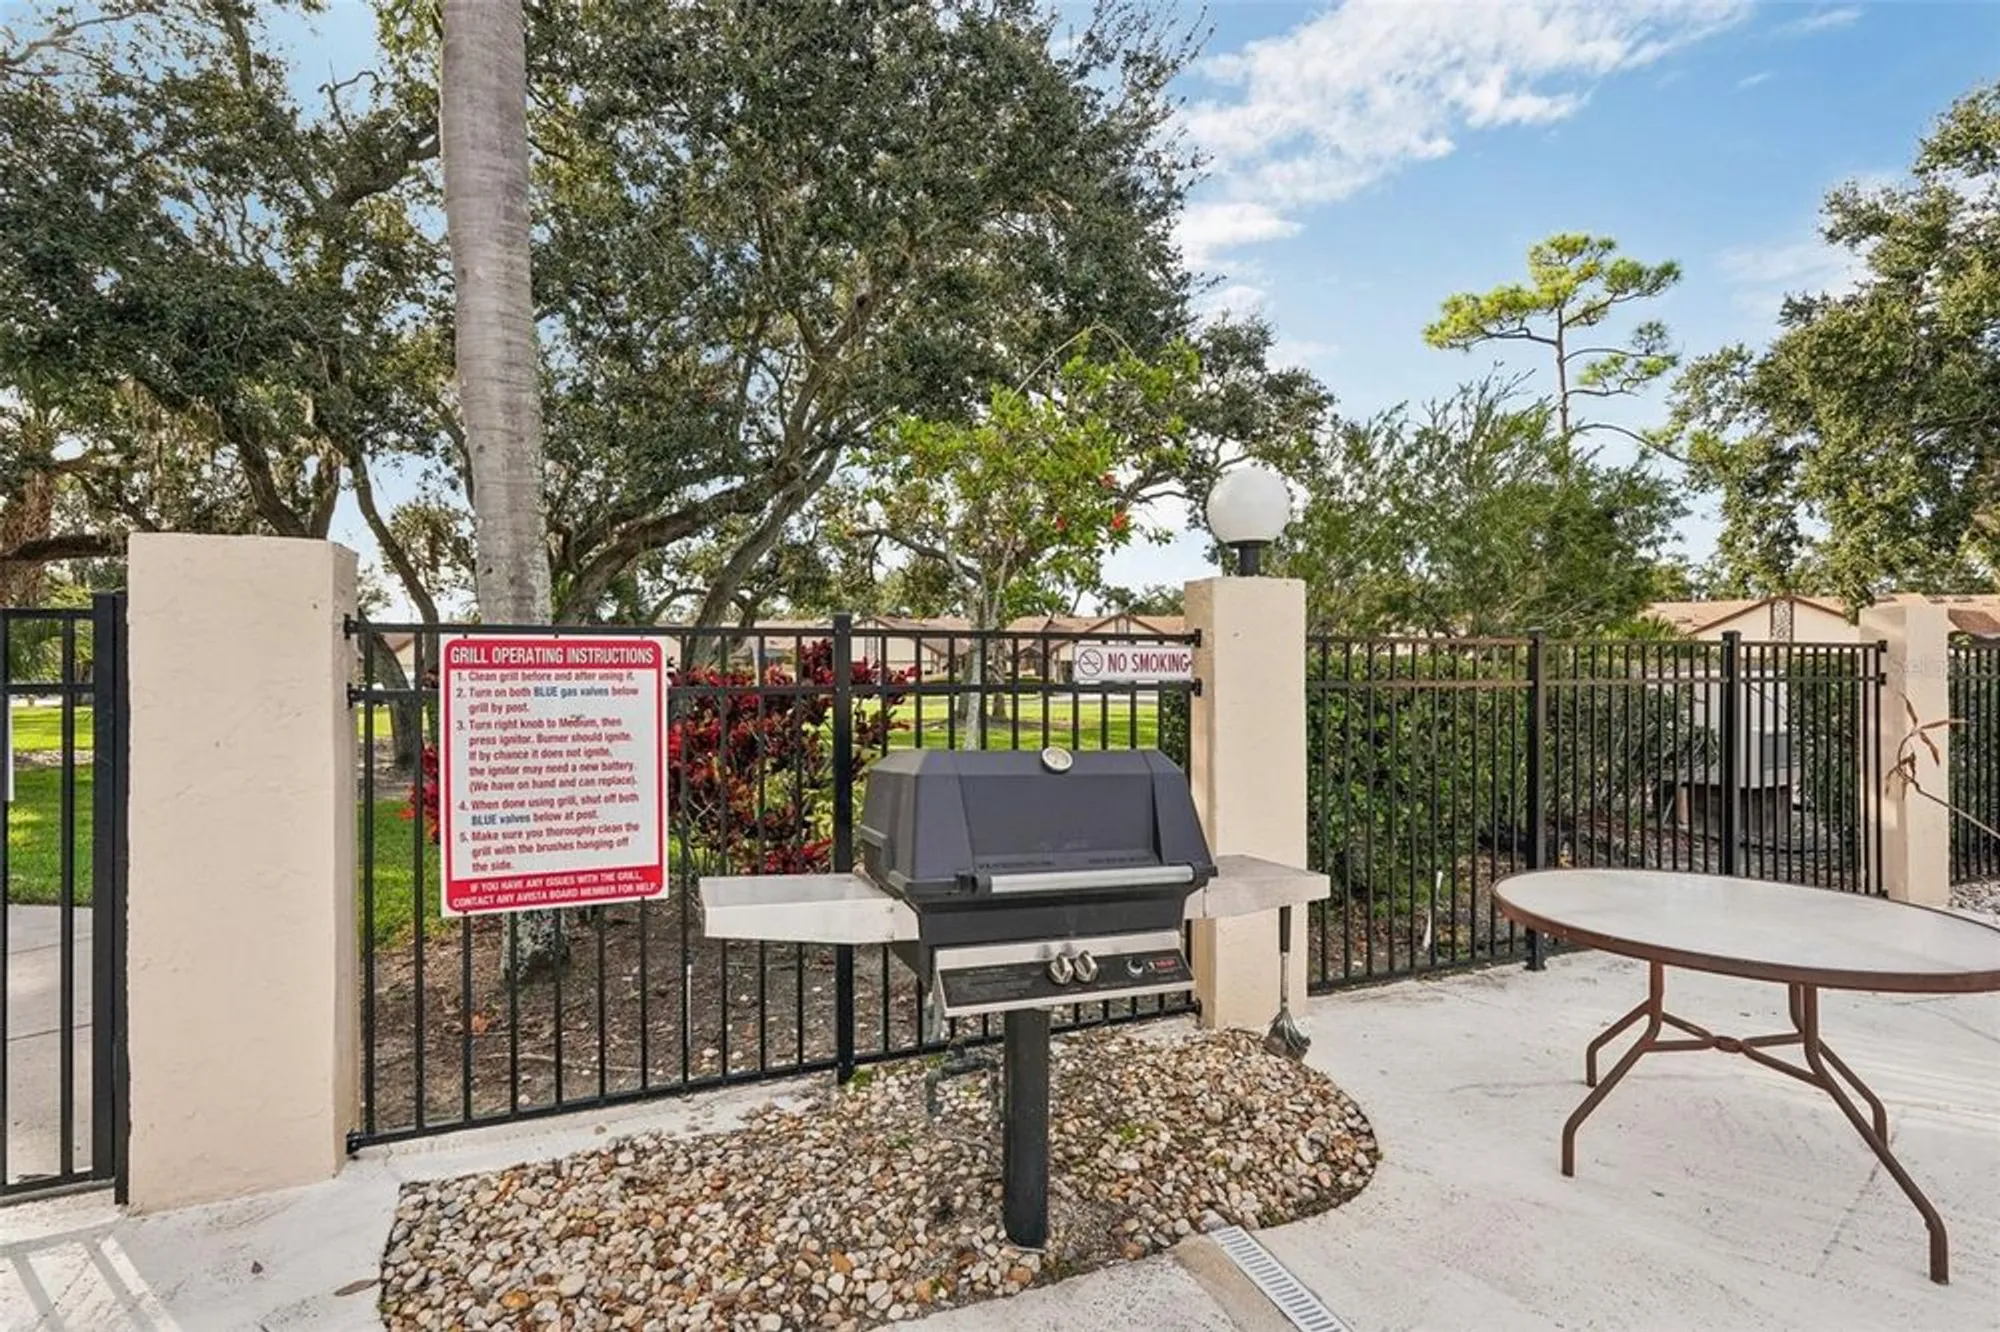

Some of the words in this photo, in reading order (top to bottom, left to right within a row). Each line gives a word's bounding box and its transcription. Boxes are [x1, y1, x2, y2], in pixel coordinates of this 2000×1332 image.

[451, 647, 488, 664] GRILL
[492, 647, 563, 664] OPERATING
[566, 647, 654, 664] INSTRUCTIONS
[1108, 653, 1127, 673] NO
[1131, 653, 1190, 673] SMOKING
[457, 672, 466, 681] 1.
[468, 672, 497, 681] Clean
[500, 672, 519, 683] grill
[521, 671, 552, 681] before
[555, 672, 573, 681] and
[575, 671, 596, 681] after
[599, 671, 624, 682] using
[626, 671, 635, 681] it.
[456, 688, 466, 698] 2.
[470, 687, 492, 697] Turn
[495, 689, 507, 697] on
[509, 687, 531, 697] both
[534, 686, 558, 697] BLUE
[561, 688, 578, 699] gas
[580, 687, 609, 696] valves
[612, 686, 639, 696] below
[468, 702, 489, 715] grill
[491, 702, 503, 714] by
[505, 703, 529, 714] post.
[456, 720, 466, 731] 3.
[470, 719, 492, 730] Turn
[495, 719, 518, 731] right
[521, 719, 544, 728] knob
[547, 718, 557, 728] to
[559, 717, 600, 729] Medium,
[602, 718, 623, 727] then
[469, 736, 497, 747] press
[500, 734, 535, 746] ignitor.
[537, 733, 569, 743] Burner
[572, 732, 603, 742] should
[469, 750, 477, 760] If
[479, 751, 491, 762] by
[494, 750, 529, 760] chance
[531, 749, 539, 758] it
[541, 748, 563, 758] does
[566, 748, 581, 757] not
[584, 747, 613, 758] ignite,
[469, 767, 485, 776] the
[488, 765, 520, 777] ignitor
[522, 766, 543, 775] may
[546, 763, 569, 773] need
[571, 764, 577, 772] a
[579, 763, 599, 771] new
[469, 781, 489, 794] (We
[491, 781, 515, 791] have
[517, 780, 530, 789] on
[532, 779, 556, 789] hand
[559, 779, 577, 788] and
[579, 778, 596, 787] can
[458, 801, 468, 811] 4.
[471, 800, 500, 811] When
[502, 799, 526, 809] done
[528, 798, 555, 809] using
[557, 795, 580, 807] grill,
[582, 794, 601, 805] shut
[604, 793, 617, 803] off
[619, 793, 640, 803] both
[472, 814, 497, 826] BLUE
[500, 813, 531, 824] valves
[533, 811, 562, 822] below
[565, 811, 575, 820] at
[577, 809, 599, 821] post.
[459, 831, 469, 842] 5.
[472, 831, 499, 841] Make
[502, 830, 524, 840] sure
[526, 829, 544, 840] you
[546, 826, 596, 837] thoroughly
[598, 823, 623, 834] clean
[625, 822, 640, 832] the
[472, 846, 492, 859] grill
[494, 844, 516, 855] with
[518, 843, 535, 853] the
[537, 840, 575, 852] brushes
[577, 839, 614, 850] hanging
[617, 837, 629, 847] off
[472, 861, 489, 872] the
[491, 860, 514, 871] side.
[470, 883, 479, 893] IF
[482, 881, 499, 892] YOU
[501, 879, 524, 890] HAVE
[526, 877, 544, 888] ANY
[546, 875, 576, 887] ISSUES
[578, 874, 599, 885] WITH
[600, 872, 616, 882] THE
[453, 894, 495, 908] CONTACT
[497, 892, 515, 904] ANY
[517, 890, 548, 902] AVISTA
[549, 887, 579, 899] BOARD
[581, 885, 617, 897] MEMBER
[618, 883, 635, 894] FOR
